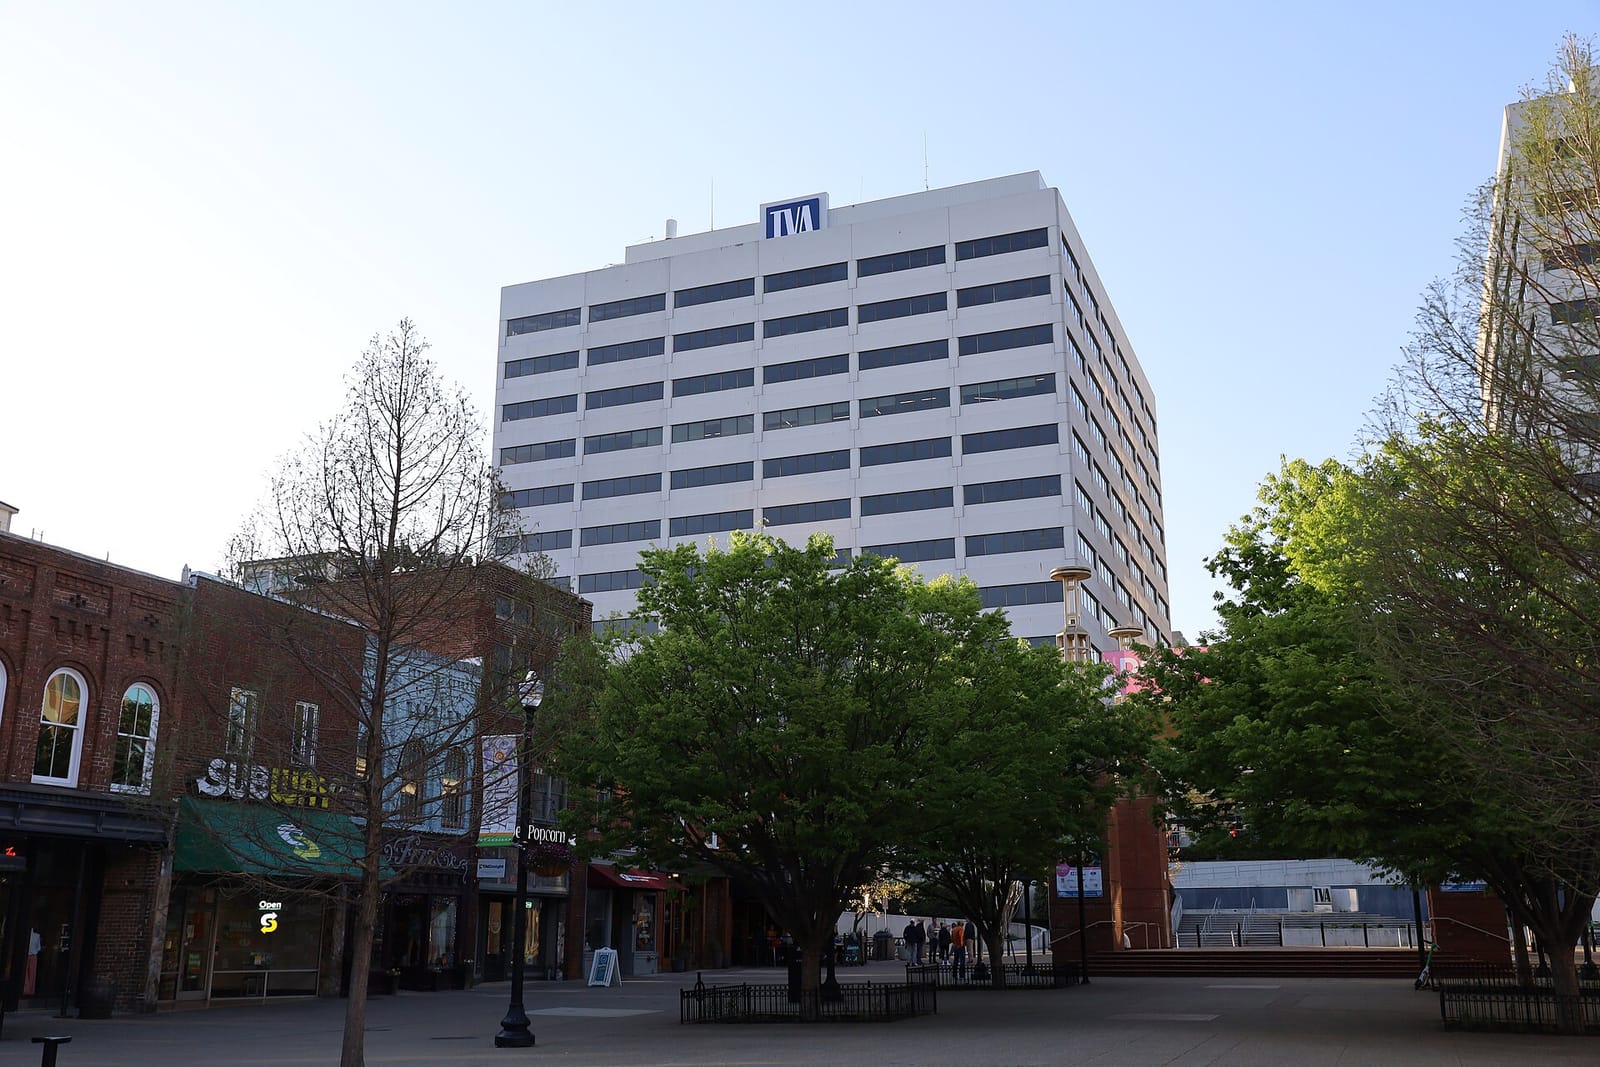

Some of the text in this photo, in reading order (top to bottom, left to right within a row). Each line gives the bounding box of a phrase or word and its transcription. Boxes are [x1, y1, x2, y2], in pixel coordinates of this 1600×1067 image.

[770, 205, 813, 238] TVA
[528, 824, 566, 845] Popcorn
[1313, 887, 1331, 902] TVA
[258, 900, 282, 909] Open
